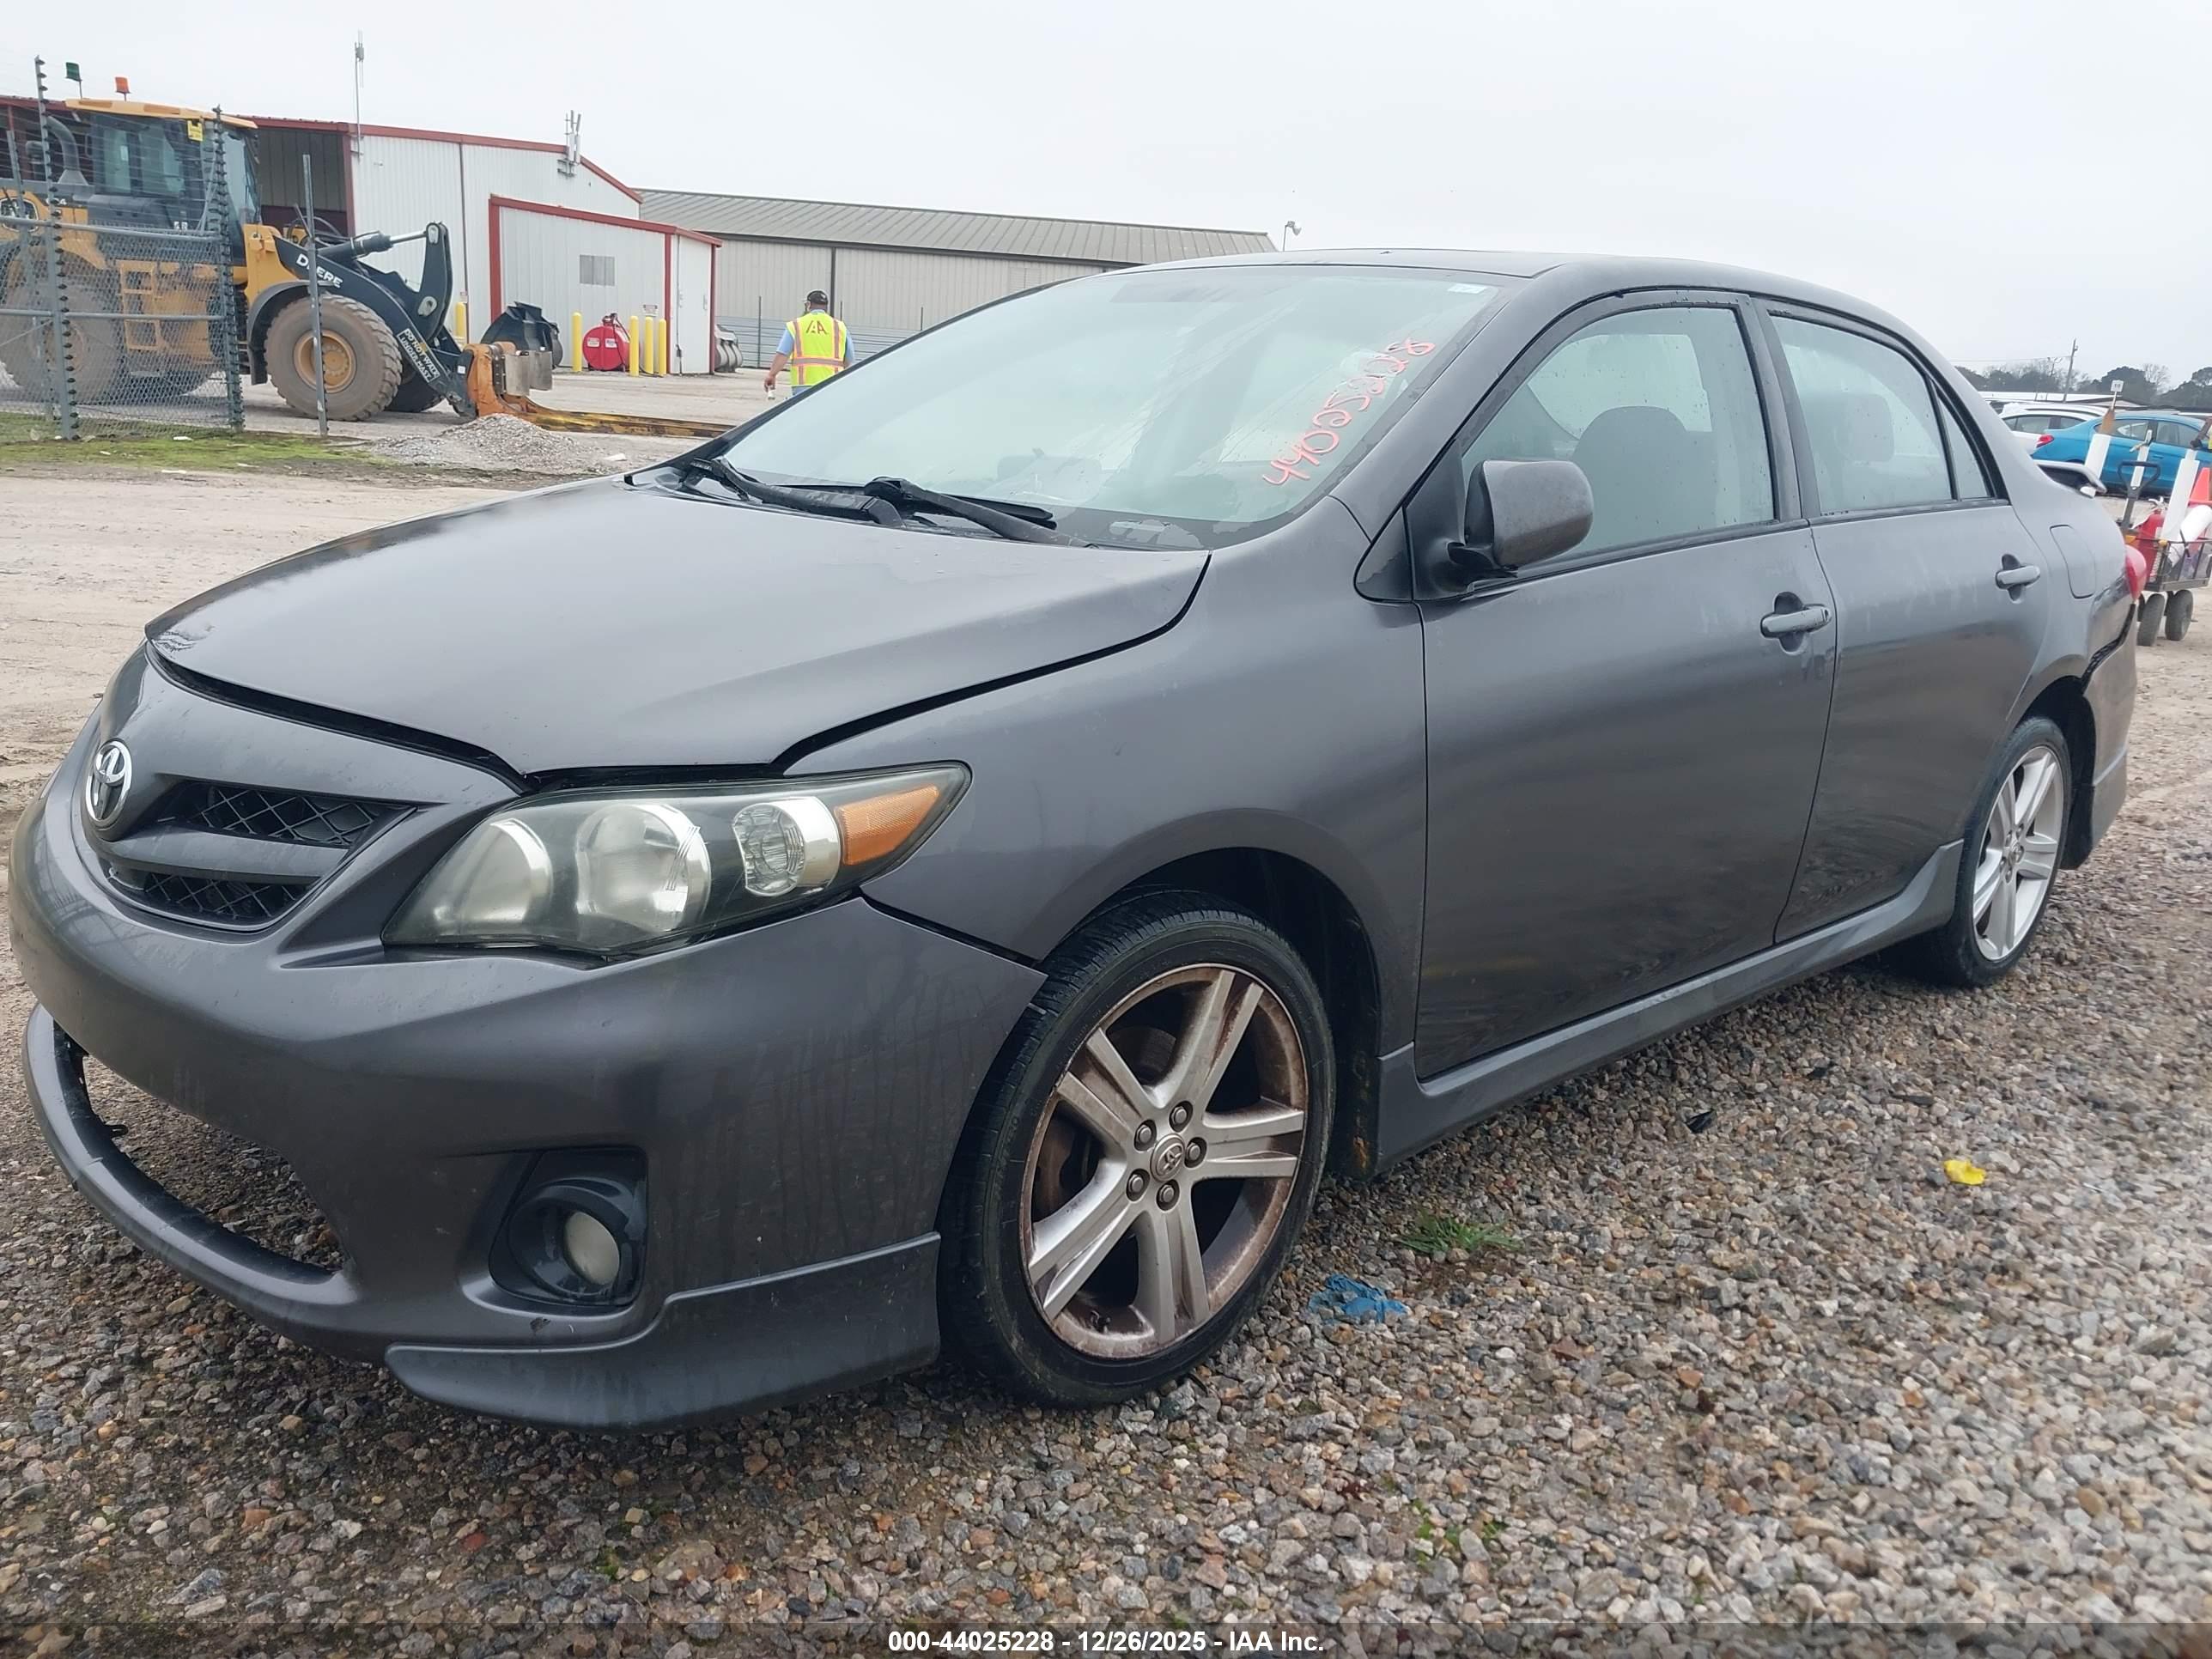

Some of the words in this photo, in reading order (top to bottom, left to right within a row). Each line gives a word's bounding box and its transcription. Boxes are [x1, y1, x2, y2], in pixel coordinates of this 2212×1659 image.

[295, 253, 343, 289] DERE
[400, 336, 419, 362] UNDER
[404, 330, 415, 342] DO
[411, 341, 427, 358] NOT
